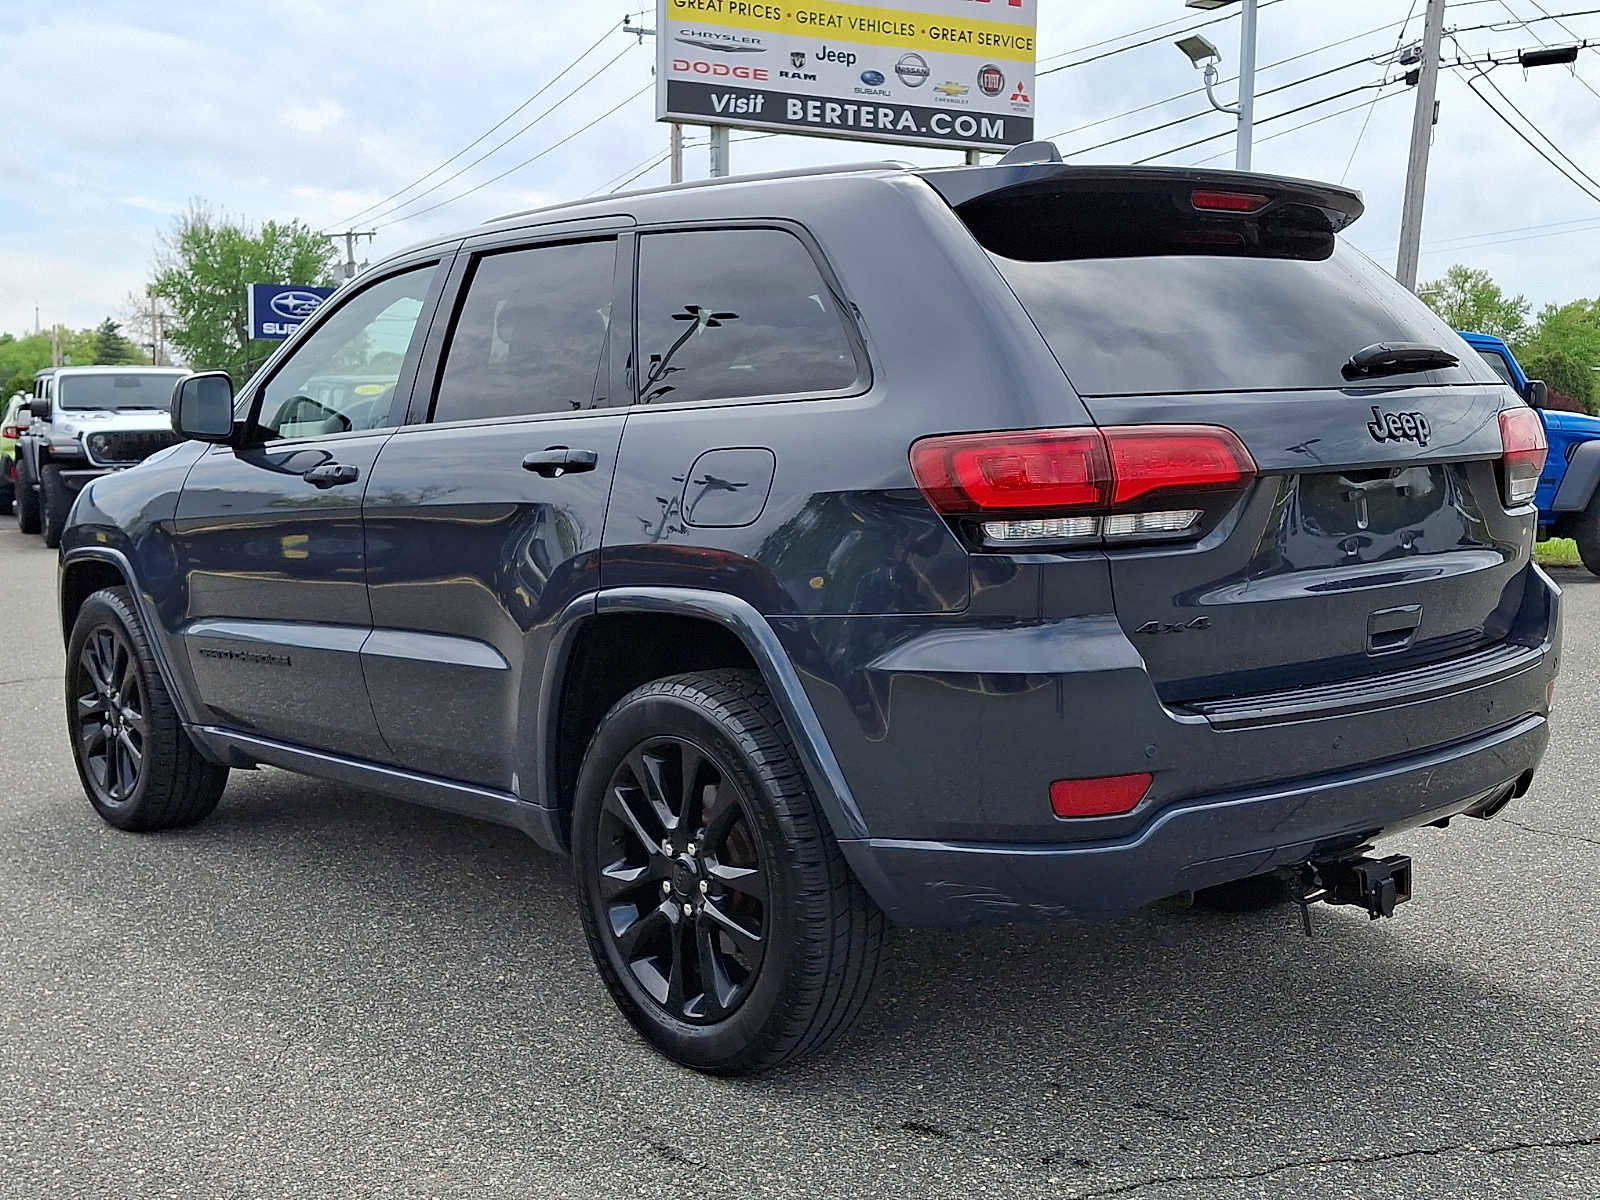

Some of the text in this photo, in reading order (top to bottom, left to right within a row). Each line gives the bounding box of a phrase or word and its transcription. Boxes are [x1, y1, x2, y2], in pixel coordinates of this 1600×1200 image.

[674, 0, 1033, 51] GREAT PRICES GREAT VEHICLES GREAT SERVICE
[679, 29, 761, 44] CHRYSLER
[815, 45, 856, 67] Jeep
[673, 59, 769, 81] DODGE
[779, 70, 817, 81] RAM
[898, 65, 927, 76] NISSAN
[854, 87, 891, 97] SUBARU
[711, 94, 1005, 140] Visit BERTERA.COM
[1367, 405, 1431, 447] Jeep
[1135, 615, 1210, 634] 4x4
